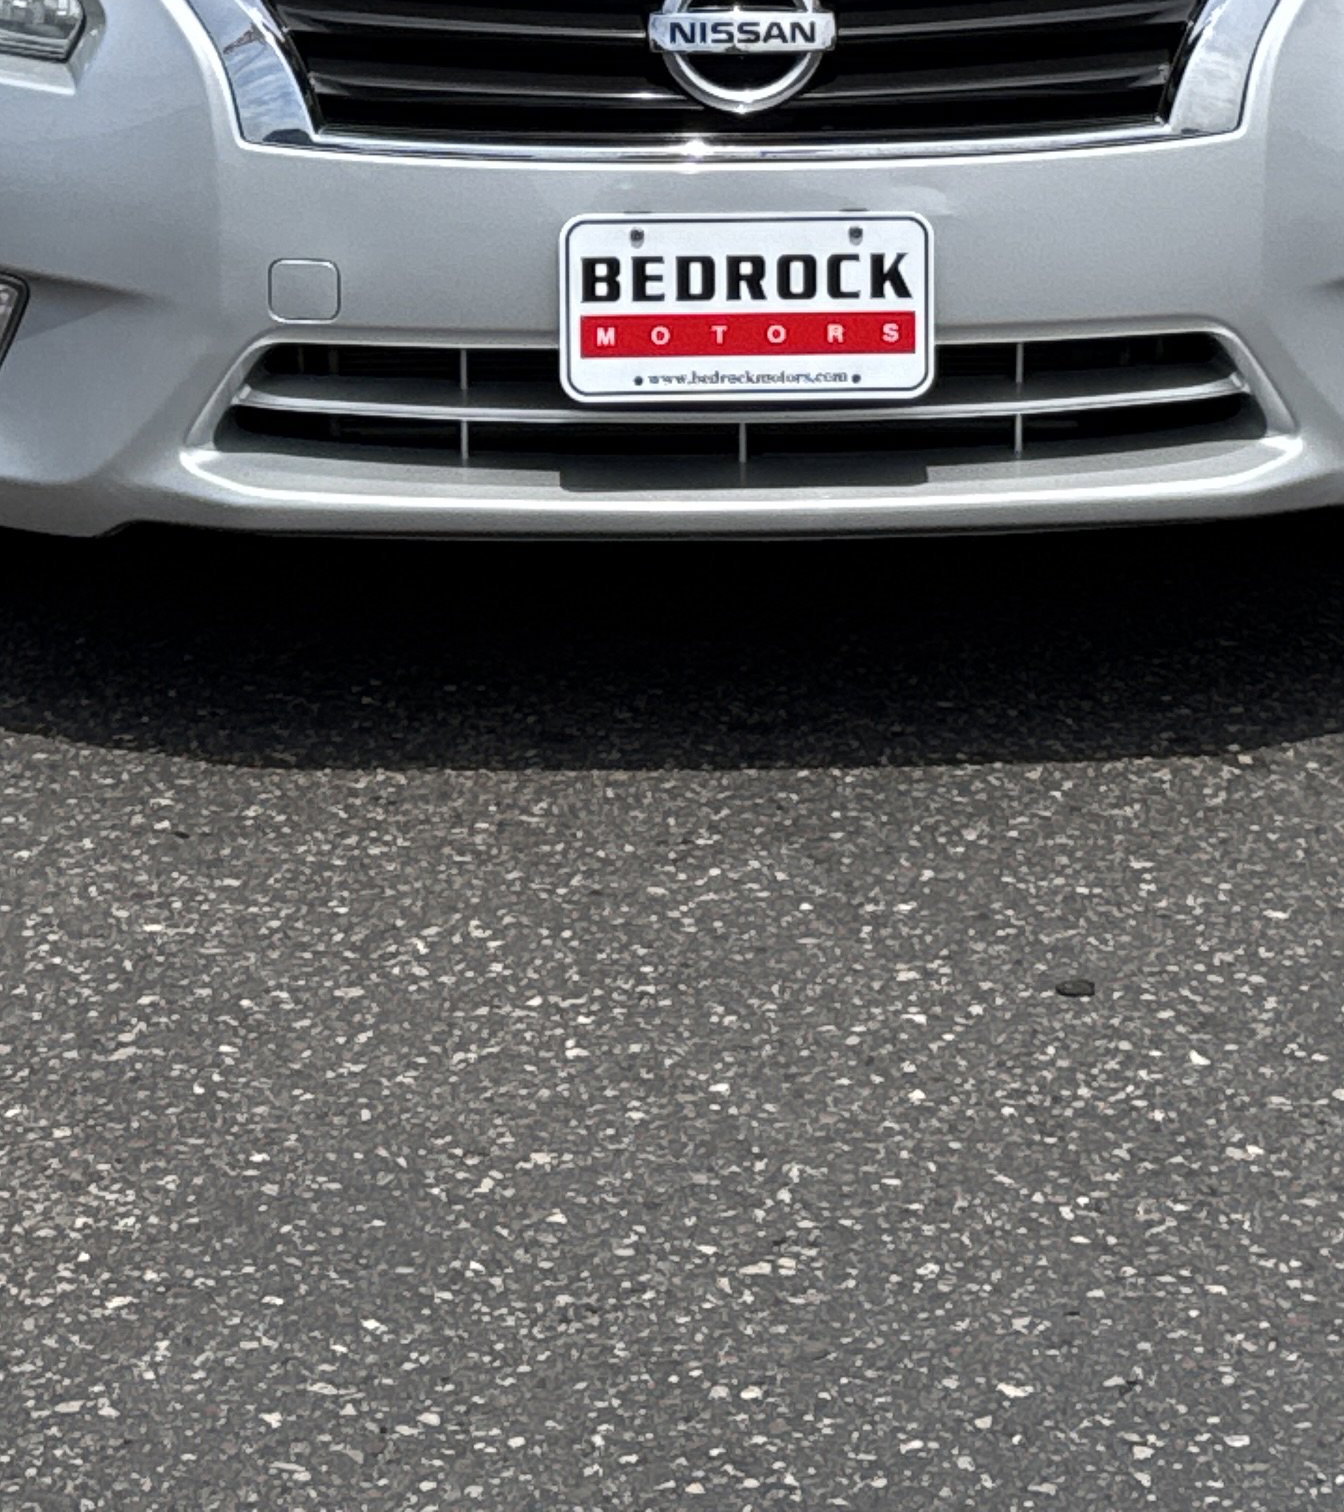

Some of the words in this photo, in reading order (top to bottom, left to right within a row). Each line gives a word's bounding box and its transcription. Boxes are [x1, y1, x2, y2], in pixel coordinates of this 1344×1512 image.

[669, 21, 816, 44] NISSAN
[580, 253, 913, 303] BEDROCK
[596, 323, 901, 347] MOTORS
[648, 370, 849, 386] www.bedrockmotors.com
